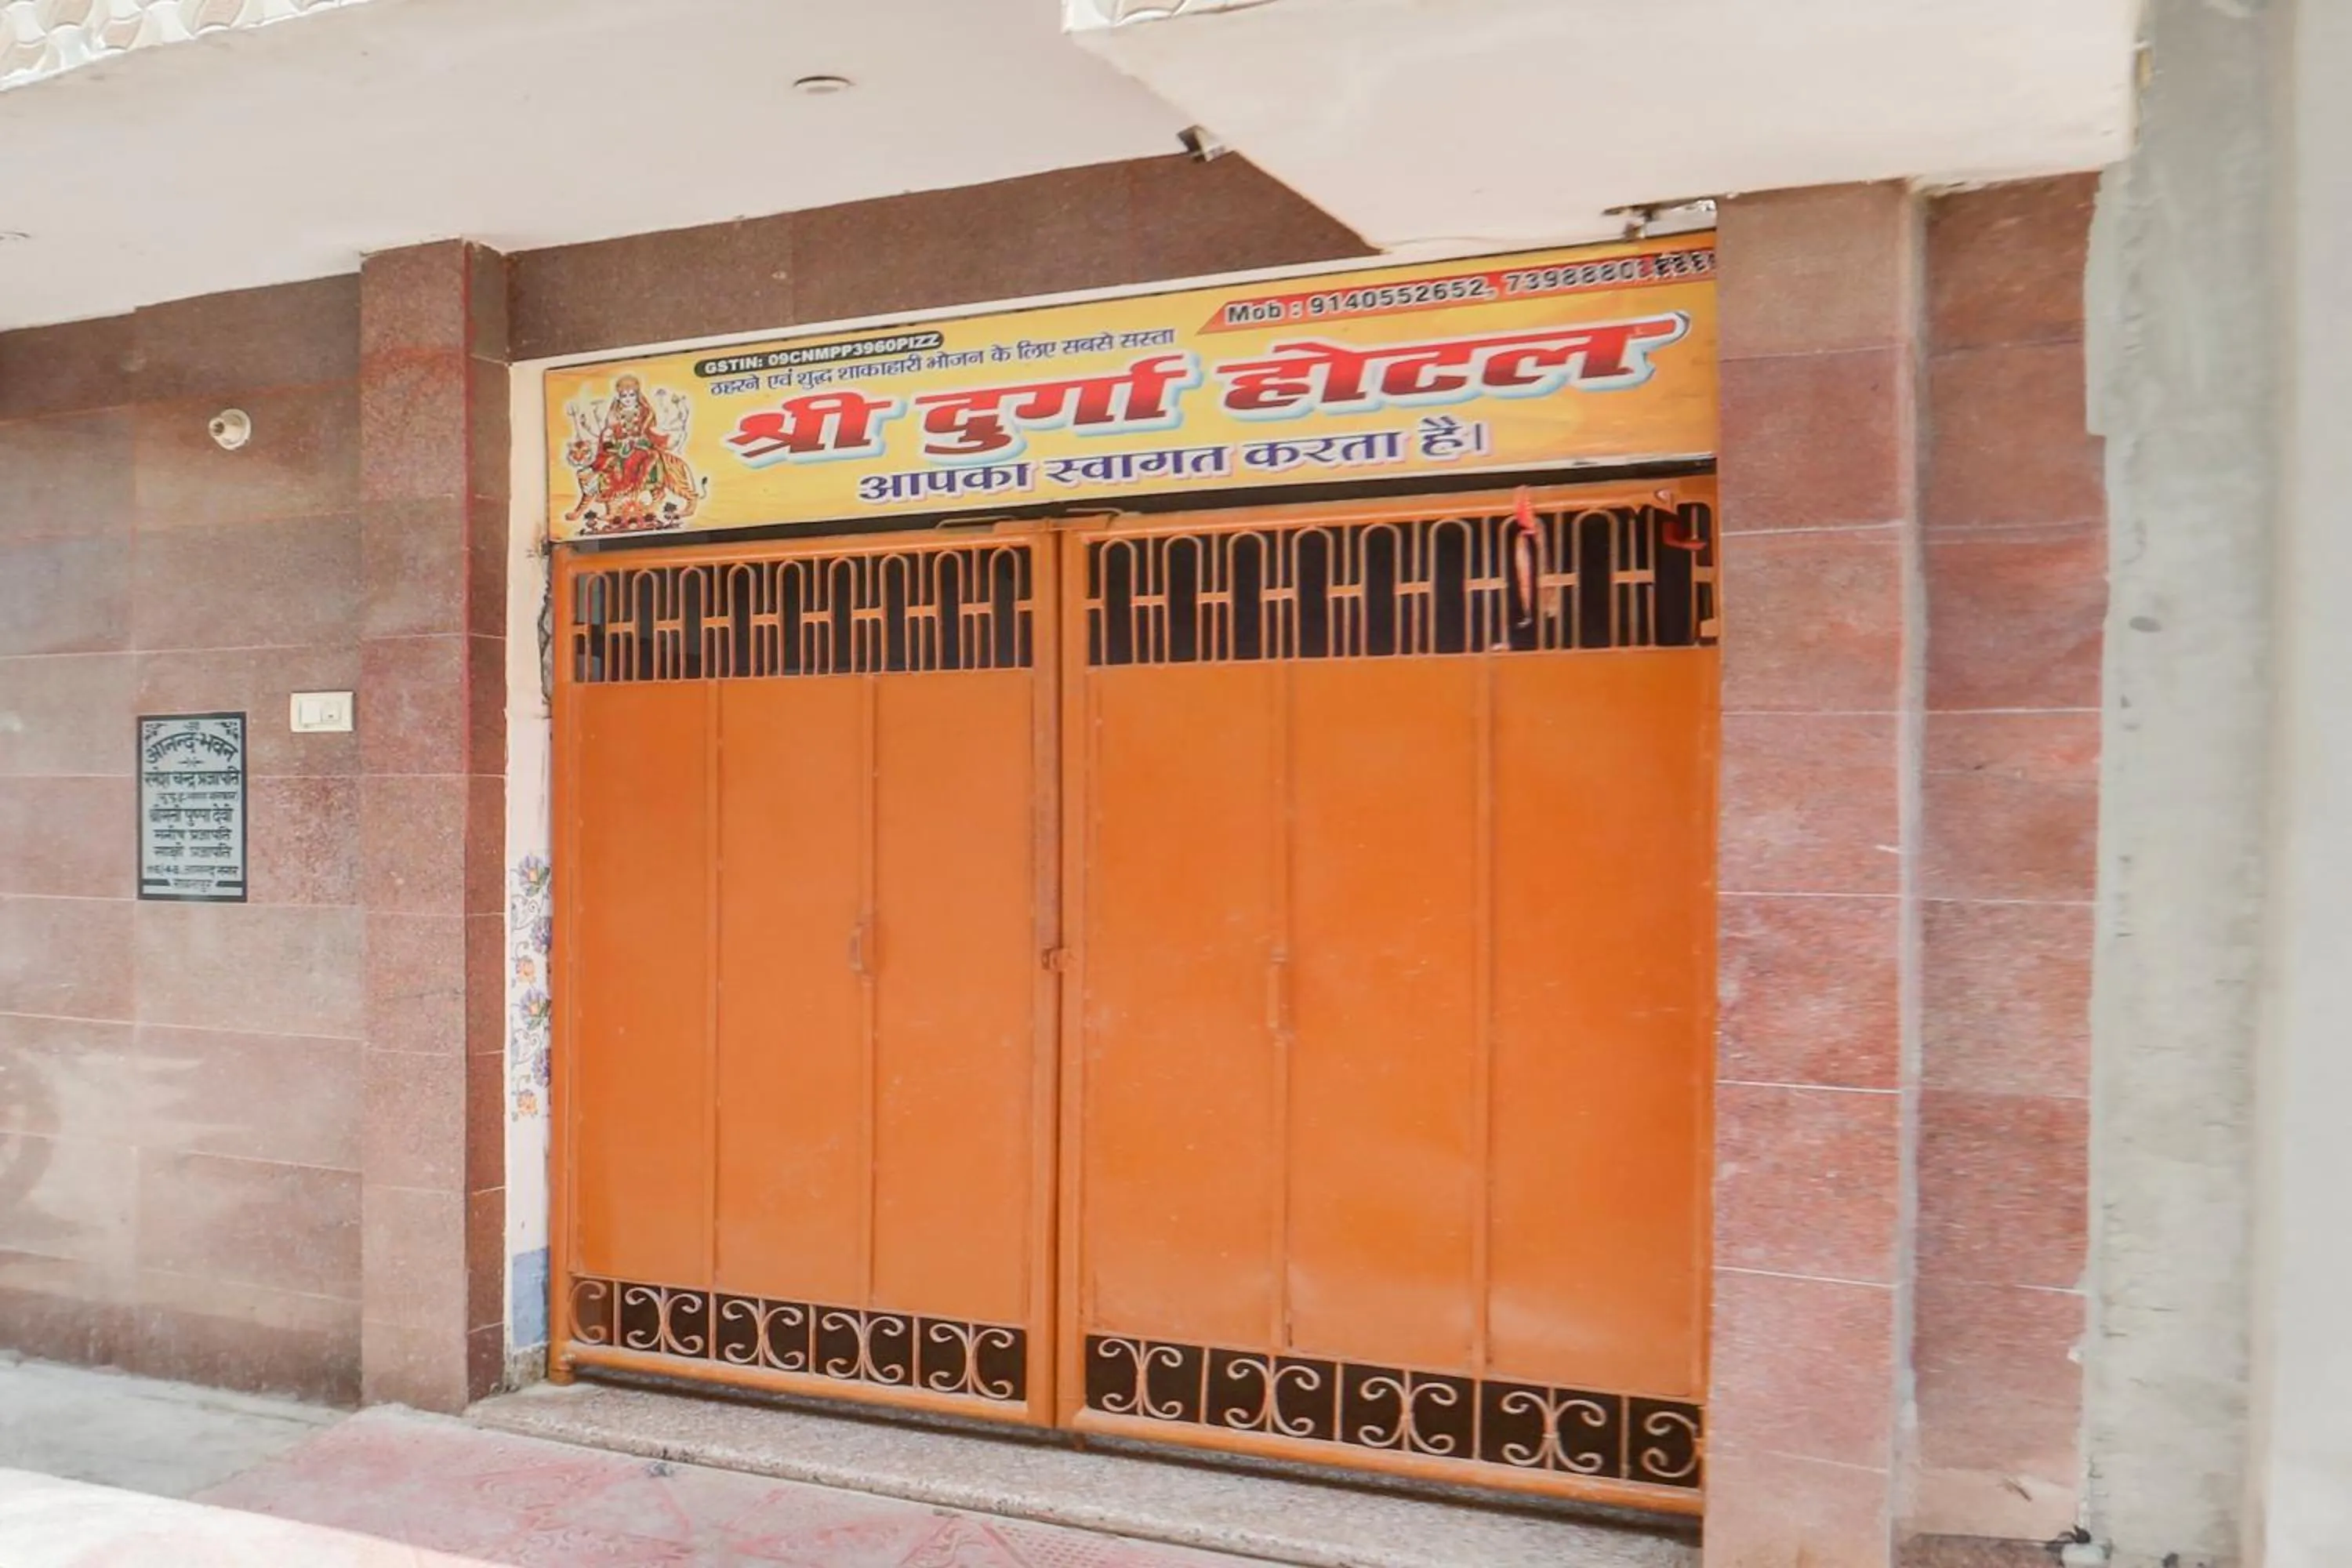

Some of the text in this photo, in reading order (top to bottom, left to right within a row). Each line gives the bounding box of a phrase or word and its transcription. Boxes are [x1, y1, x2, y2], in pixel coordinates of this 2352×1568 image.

[1228, 303, 1283, 323] Mob
[705, 355, 763, 375] GSTIN:
[710, 328, 1174, 395] ठहरने एवं शुद्ध शाकाहारी भोजन के लिए सबसे सस्ता
[728, 317, 1679, 459] श्री दुर्गा होटल
[859, 463, 1030, 500] आपका
[1045, 446, 1229, 484] स्वागत
[1243, 431, 1403, 467] करता
